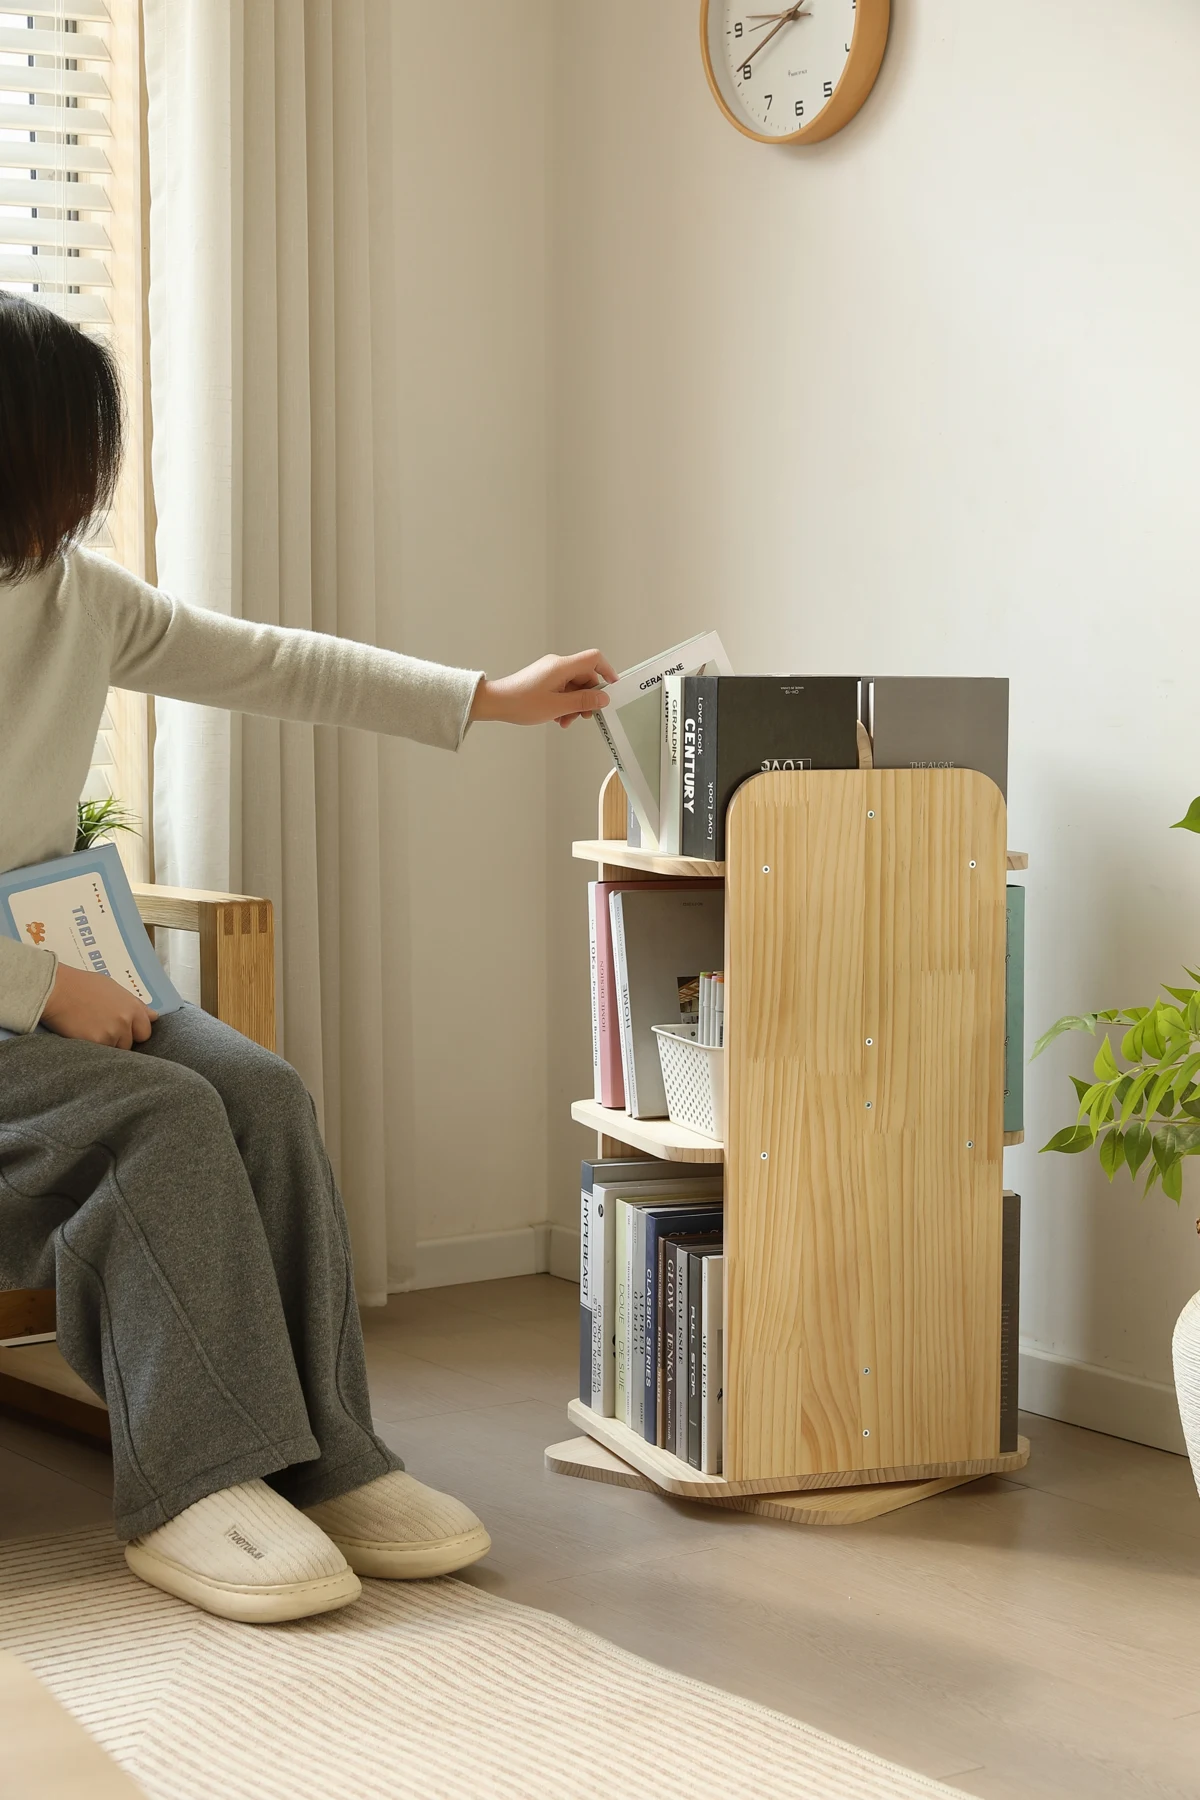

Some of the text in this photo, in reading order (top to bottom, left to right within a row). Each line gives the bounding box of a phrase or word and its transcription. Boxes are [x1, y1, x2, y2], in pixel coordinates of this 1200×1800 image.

[734, 22, 743, 38] 9
[743, 64, 752, 80] 8
[823, 81, 832, 98] 5
[764, 94, 772, 110] 7
[795, 100, 804, 116] 6
[639, 662, 684, 690] GERADINE
[596, 712, 625, 773] GERALDINE
[684, 718, 696, 814] CENTURY
[622, 983, 630, 1028] HOME
[619, 1341, 624, 1360] DE
